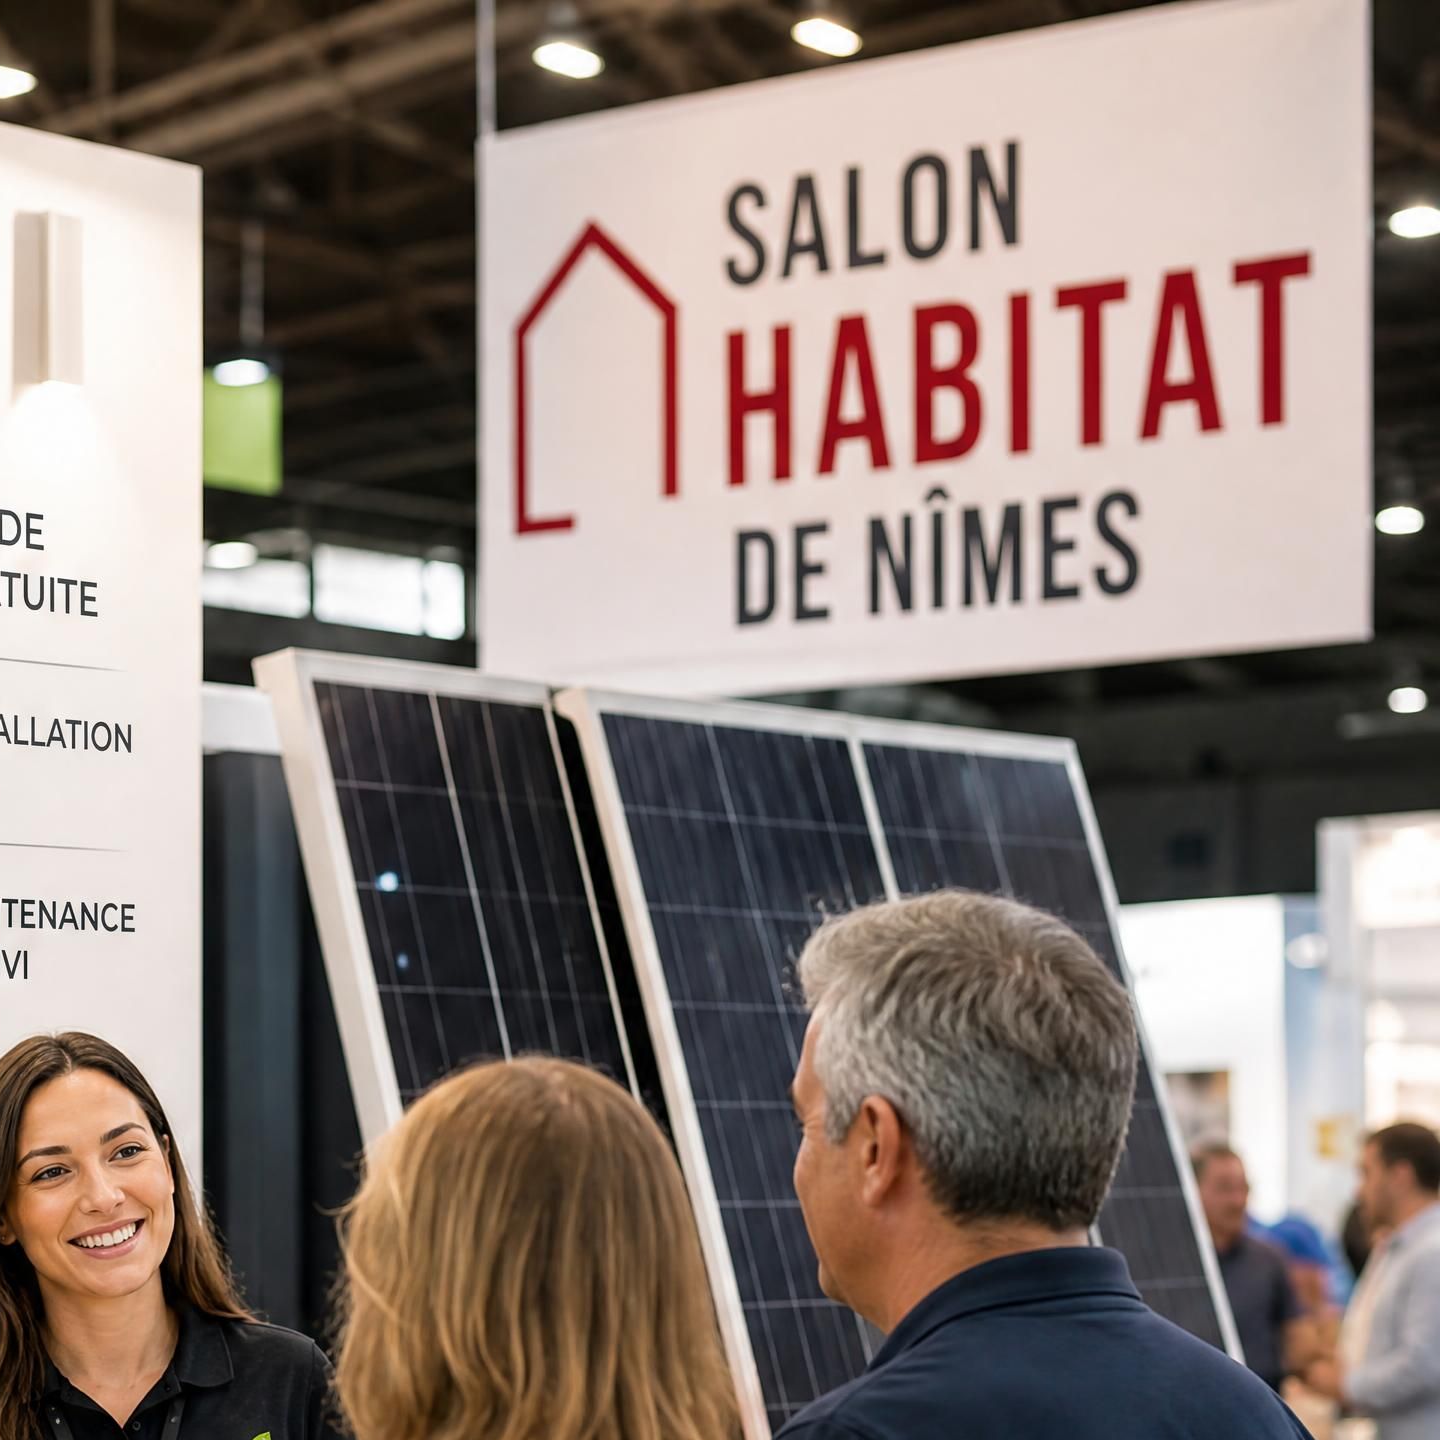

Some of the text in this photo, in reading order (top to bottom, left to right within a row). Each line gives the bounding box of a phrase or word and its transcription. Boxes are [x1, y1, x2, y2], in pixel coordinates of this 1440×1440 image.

[724, 138, 1021, 288] SALON
[726, 251, 1312, 487] HABITAT
[735, 485, 1141, 627] DE NÎMES
